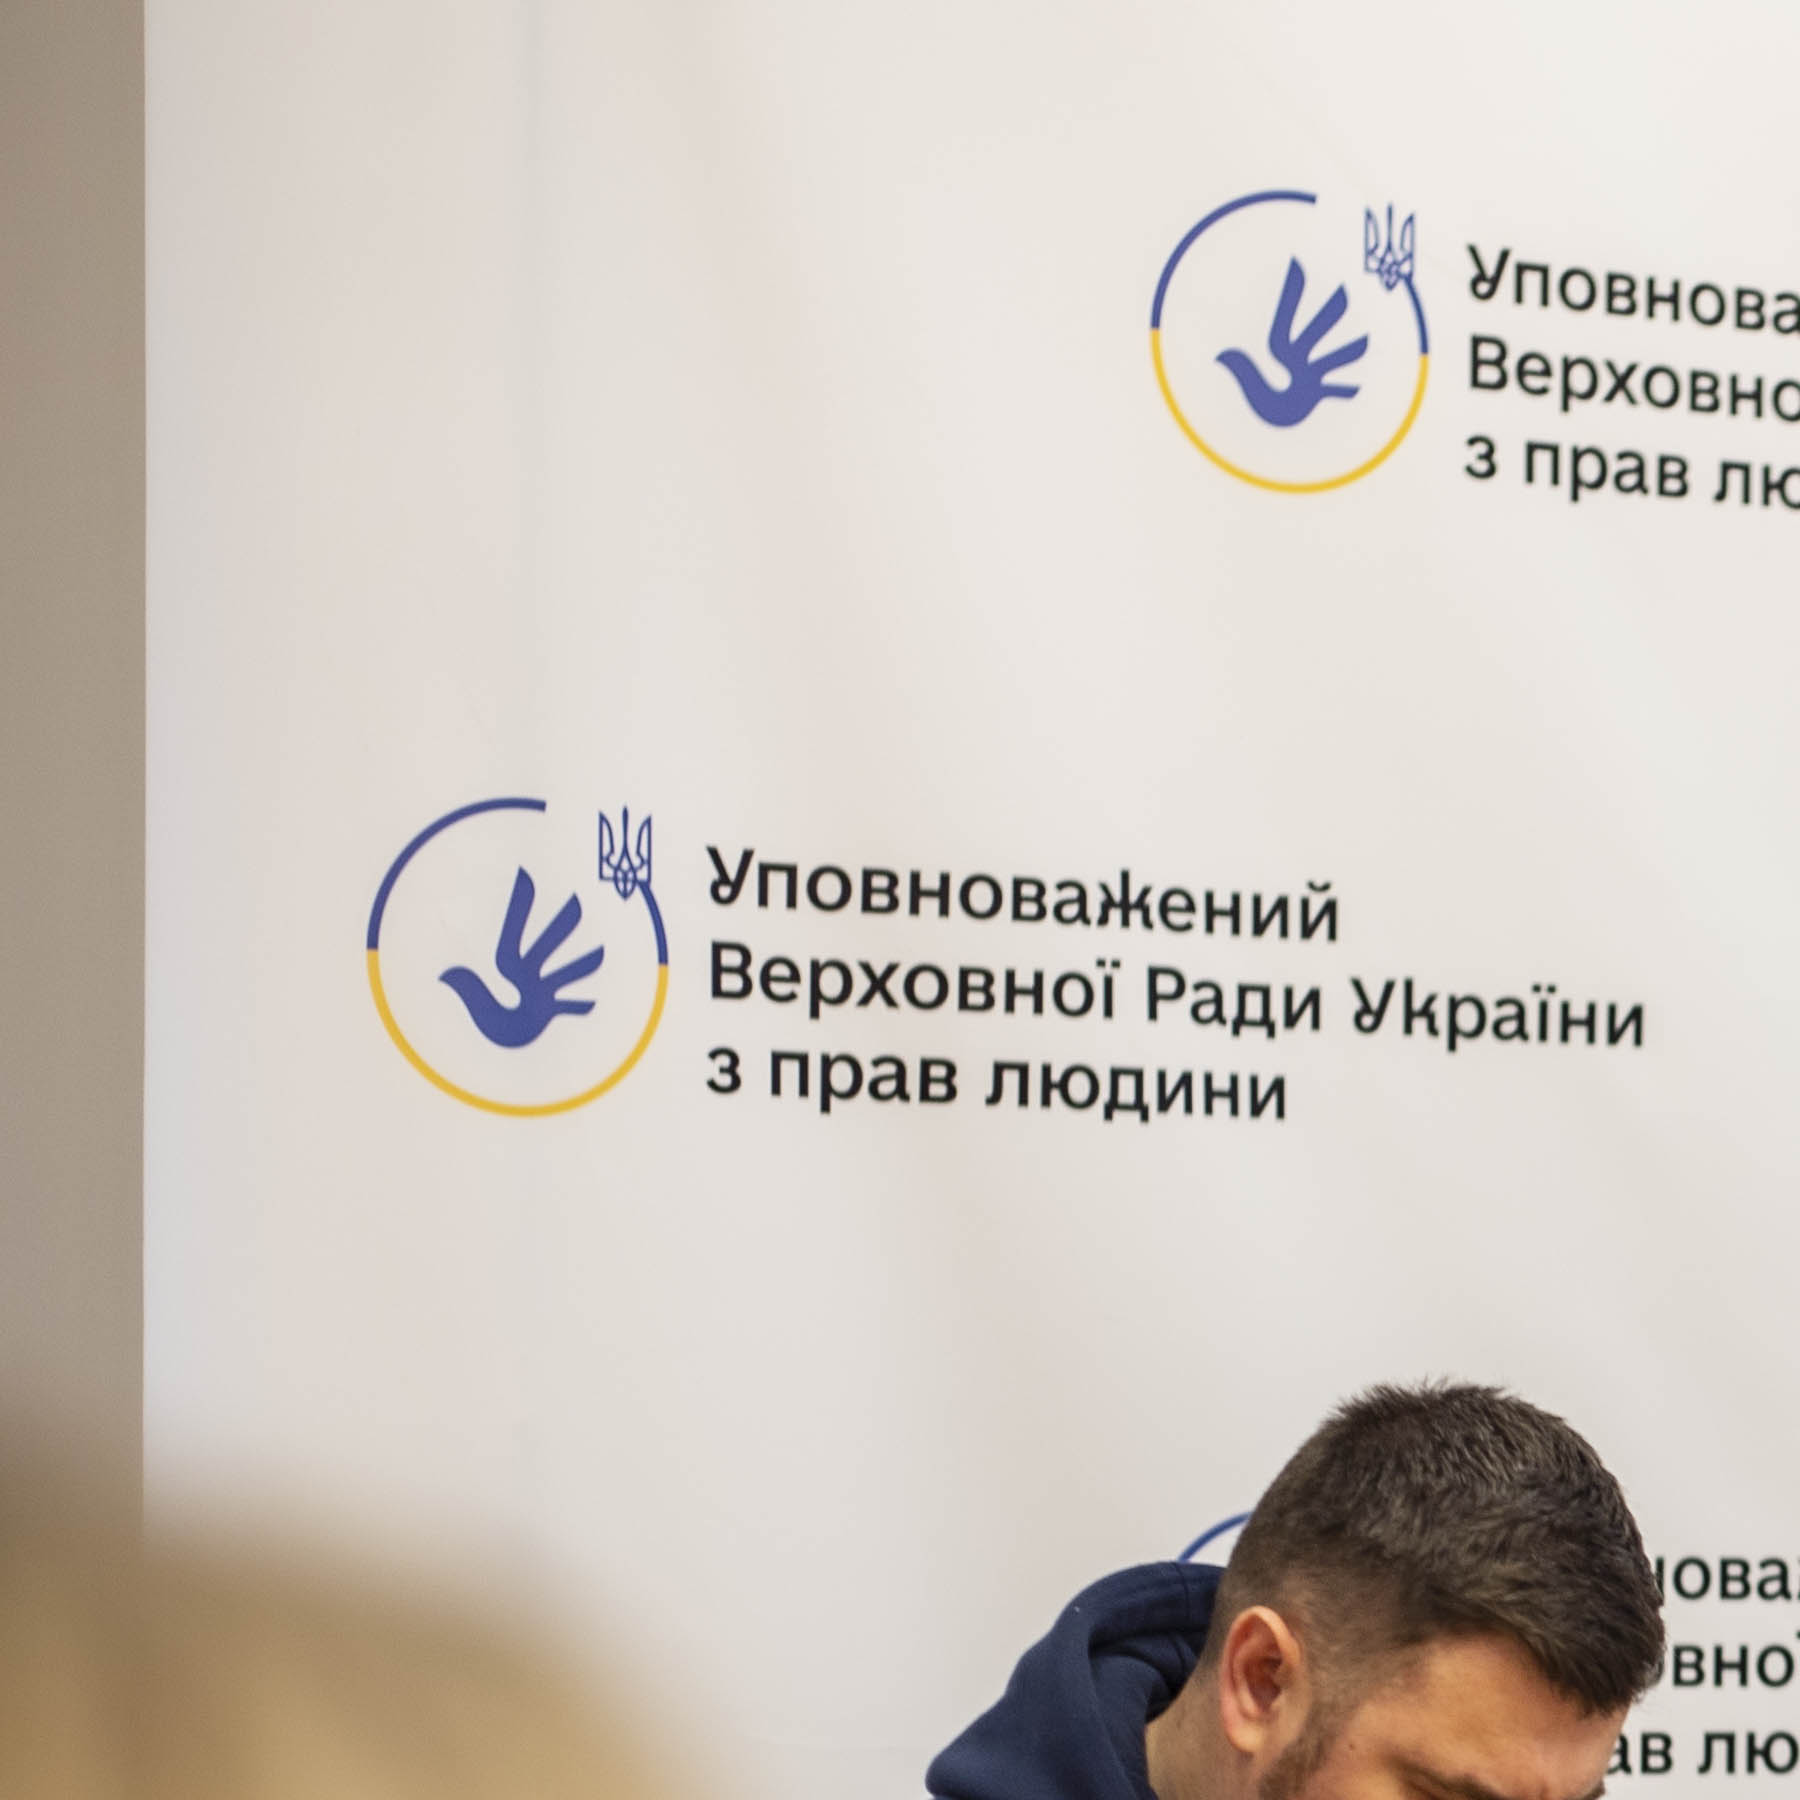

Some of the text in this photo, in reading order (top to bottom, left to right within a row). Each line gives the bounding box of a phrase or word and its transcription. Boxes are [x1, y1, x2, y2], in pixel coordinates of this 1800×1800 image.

[1464, 434, 1498, 481] з
[1524, 440, 1690, 505] прав
[705, 844, 1339, 943] Уповноважений
[710, 939, 1645, 1054] Верховної Ради України
[705, 1046, 1287, 1125] з прав людини
